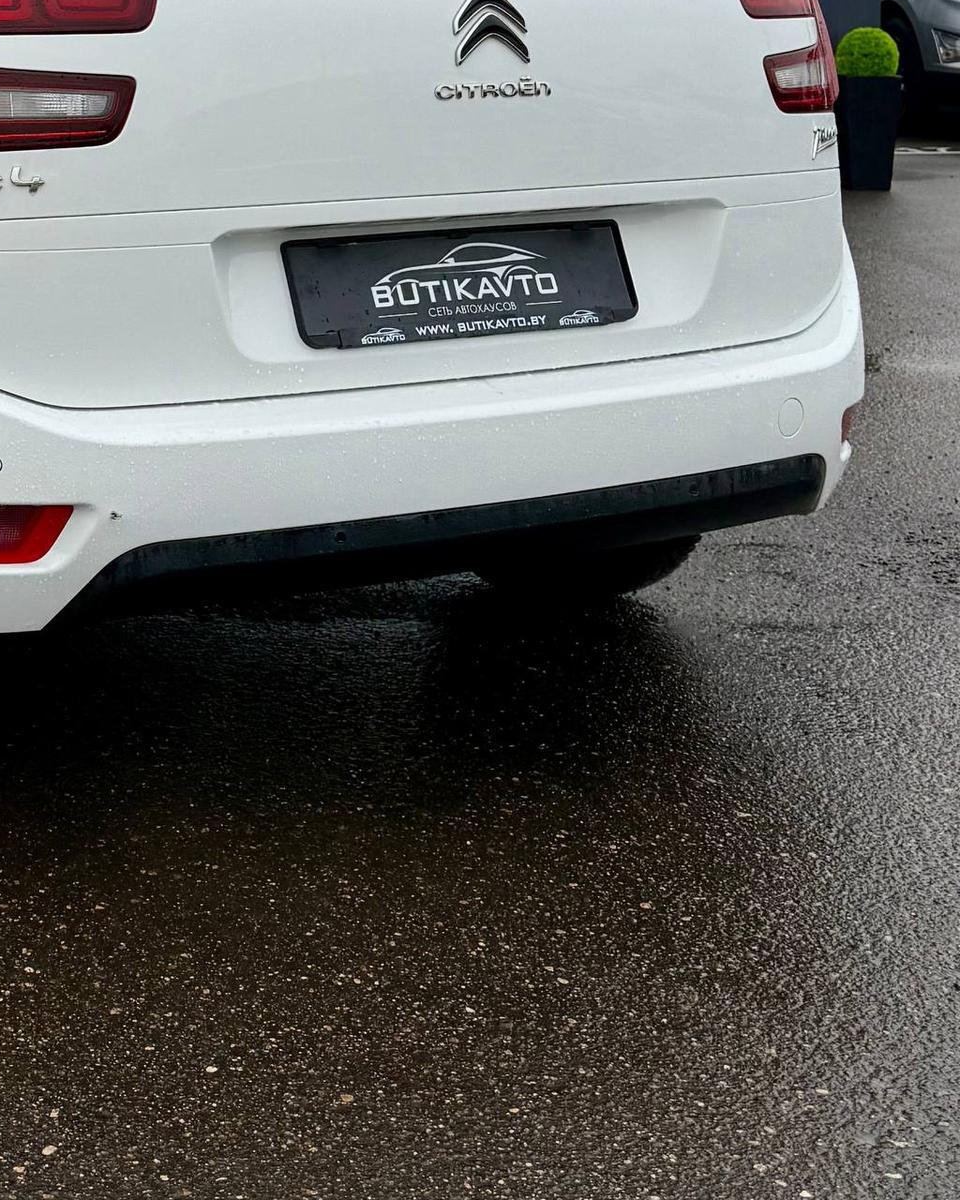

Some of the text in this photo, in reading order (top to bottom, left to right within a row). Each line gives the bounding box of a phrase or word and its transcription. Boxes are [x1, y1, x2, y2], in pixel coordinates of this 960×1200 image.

[370, 273, 559, 309] BUTIKAVTO
[428, 301, 517, 318] СЕТЬ АВТОХАУСОВ
[415, 315, 547, 336] WWW. BUTIKAVTO.BY
[361, 334, 406, 345] BUTIKAVTO
